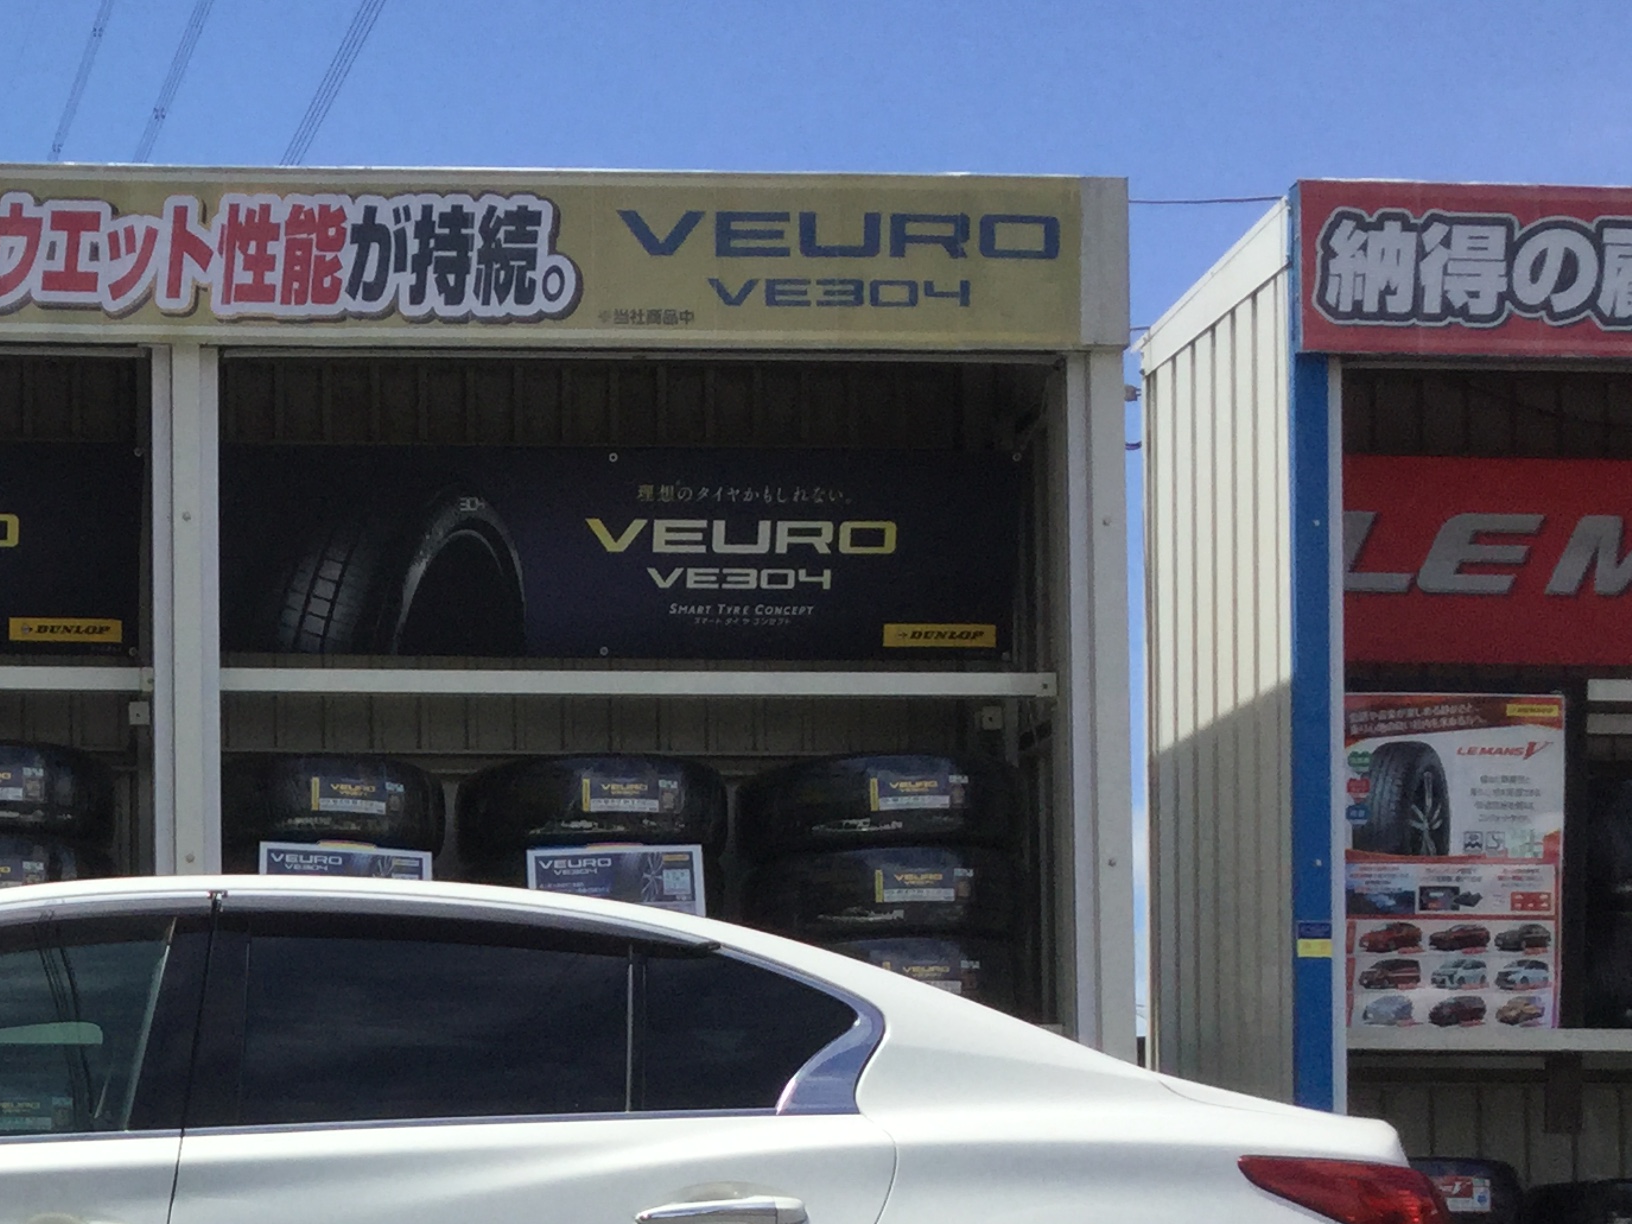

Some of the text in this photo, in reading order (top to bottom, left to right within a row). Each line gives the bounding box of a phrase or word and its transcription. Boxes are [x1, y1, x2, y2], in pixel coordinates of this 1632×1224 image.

[616, 209, 1061, 260] VEURO
[707, 277, 971, 307] VE304
[585, 518, 897, 554] VEURO
[647, 568, 831, 590] VE304
[35, 625, 111, 635] DUNLOP
[909, 630, 985, 641] DUNLOP
[601, 783, 648, 791] VEURO
[271, 853, 342, 865] VEURO
[539, 858, 612, 869] VEURO
